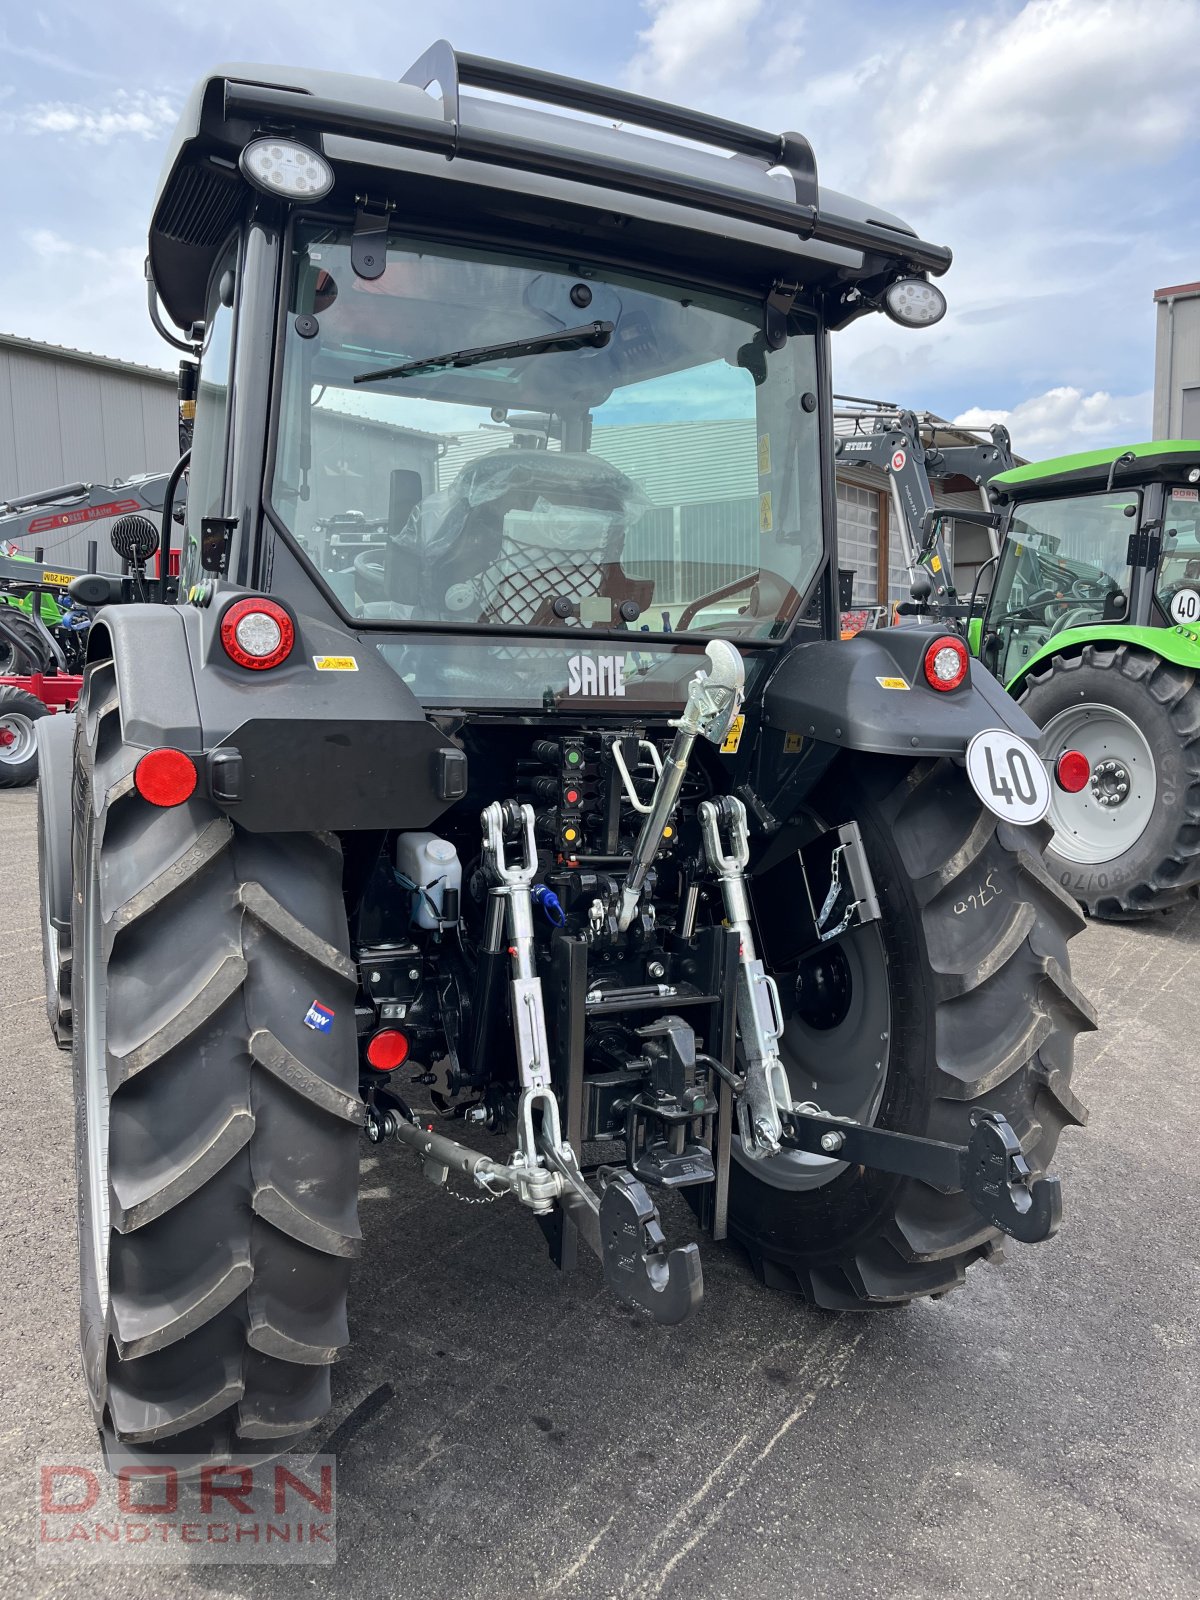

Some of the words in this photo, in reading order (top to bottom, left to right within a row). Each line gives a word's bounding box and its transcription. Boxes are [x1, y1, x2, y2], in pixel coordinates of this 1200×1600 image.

[845, 442, 872, 450] STOLL
[1178, 595, 1195, 617] 40
[568, 655, 626, 696] SAME
[984, 746, 1037, 805] 40
